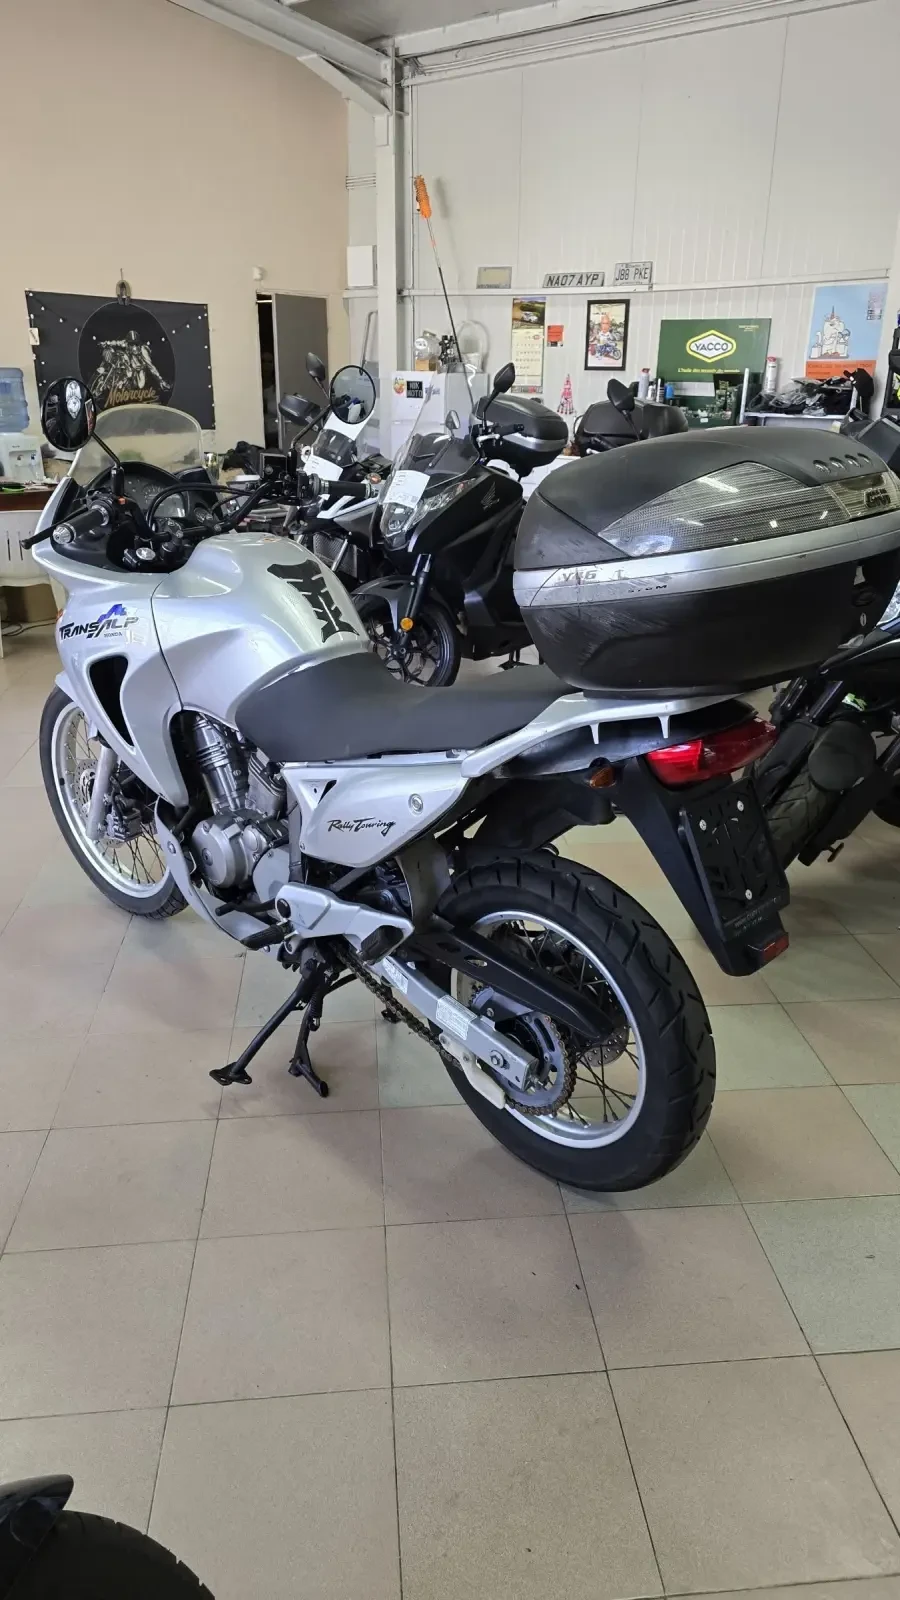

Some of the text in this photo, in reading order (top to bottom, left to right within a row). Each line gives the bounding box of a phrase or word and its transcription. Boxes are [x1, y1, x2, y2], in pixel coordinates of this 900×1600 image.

[546, 273, 600, 287] NA07 AYP
[633, 267, 649, 280] PKE
[694, 342, 729, 352] YACCO
[104, 386, 160, 408] Motorcycle
[59, 616, 139, 640] TRANSALP
[327, 816, 397, 837] Rally Touring
